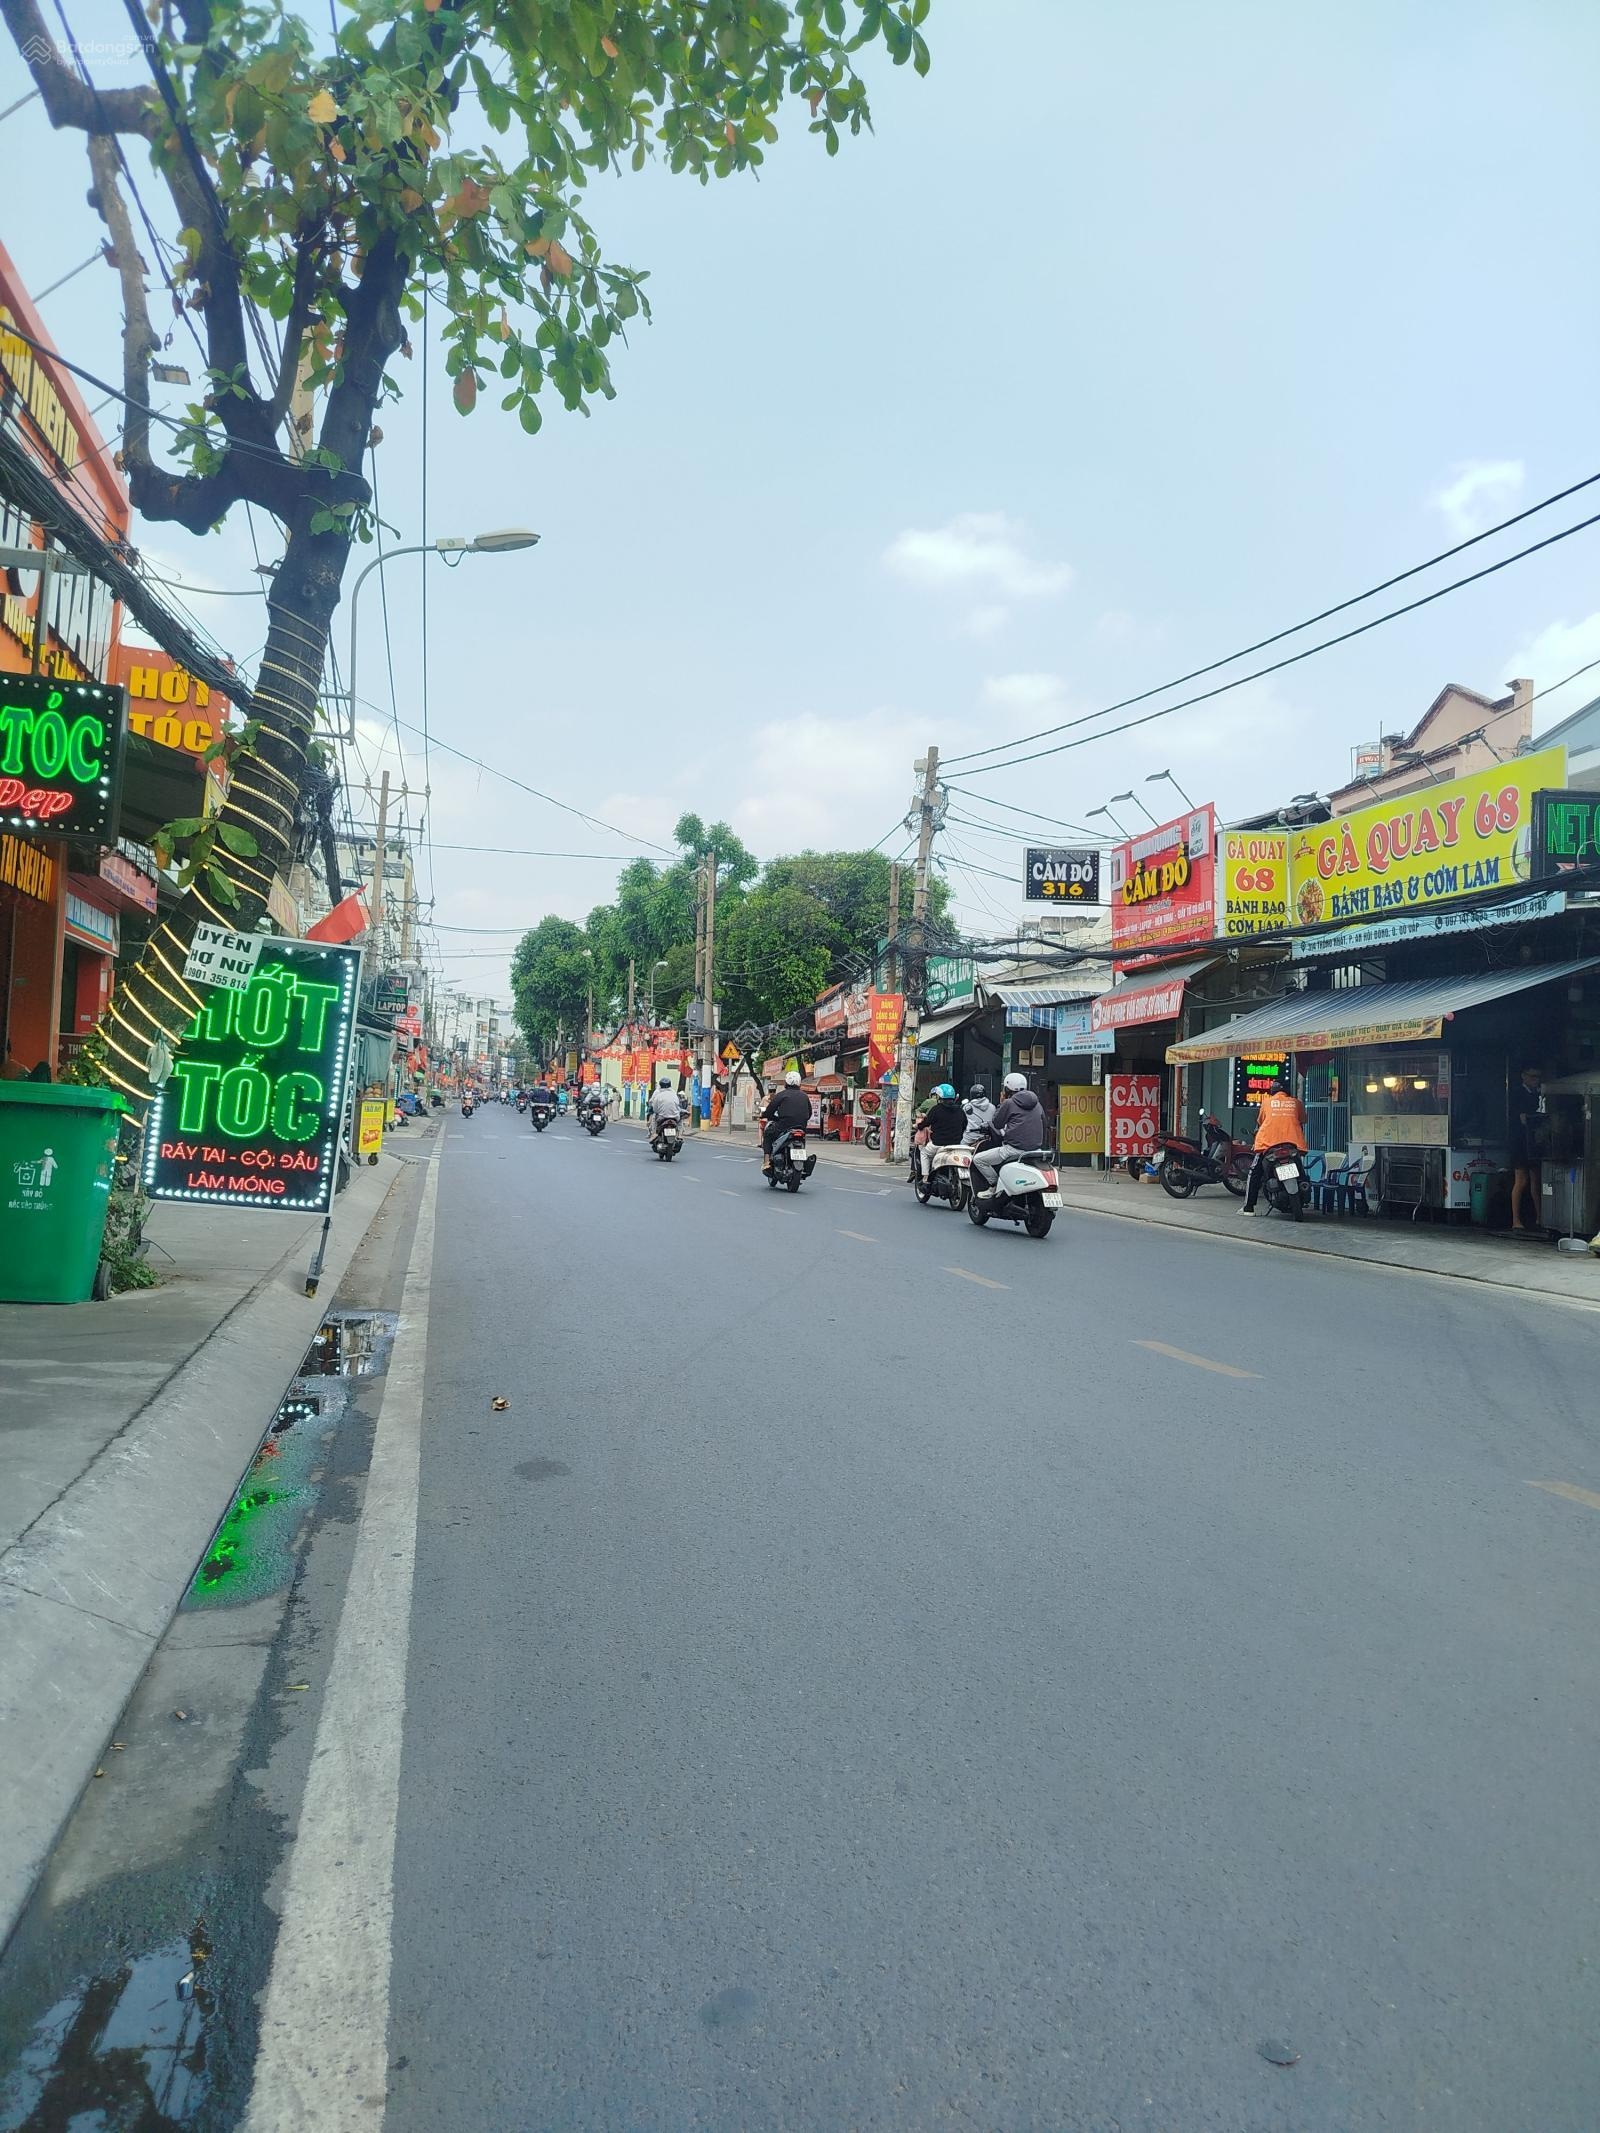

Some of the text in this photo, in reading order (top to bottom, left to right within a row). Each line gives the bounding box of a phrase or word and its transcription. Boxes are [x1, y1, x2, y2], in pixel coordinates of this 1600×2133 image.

[0, 692, 103, 783] TÓC
[129, 709, 213, 752] TÓC
[1317, 785, 1521, 878] GÀ QUAY 68
[1547, 804, 1590, 854] NET
[1227, 836, 1248, 859] GÀ
[1249, 841, 1285, 863] QUAY
[1033, 855, 1092, 882] CẦM ĐỒ
[1122, 842, 1189, 905] CẦM ĐỒ
[1235, 867, 1275, 892] 68
[1042, 883, 1084, 896] 316
[1331, 880, 1371, 918] BÁNH
[1373, 879, 1403, 909] BAO
[1423, 863, 1459, 898] CƠM
[1462, 857, 1500, 889] LAM
[1227, 898, 1286, 915] BÁNH BAO
[1227, 916, 1254, 933] CƠM
[1257, 919, 1284, 931] LAM
[198, 927, 252, 954] UYỂN
[189, 949, 254, 975] HỢ NỮ
[210, 973, 228, 986] 355
[230, 978, 247, 991] 814
[377, 1001, 406, 1012] LAPTOP
[1060, 1095, 1105, 1114] PHOTO
[1112, 1077, 1158, 1107] CẦM
[1064, 1124, 1101, 1144] COPY
[1115, 1108, 1155, 1139] ĐỒ
[161, 1142, 198, 1160] RÁY
[202, 1146, 226, 1164] TAI
[279, 1150, 319, 1171] ĐẦU
[1116, 1143, 1155, 1155] 316
[188, 1171, 287, 1195] LÀM MÓNG
